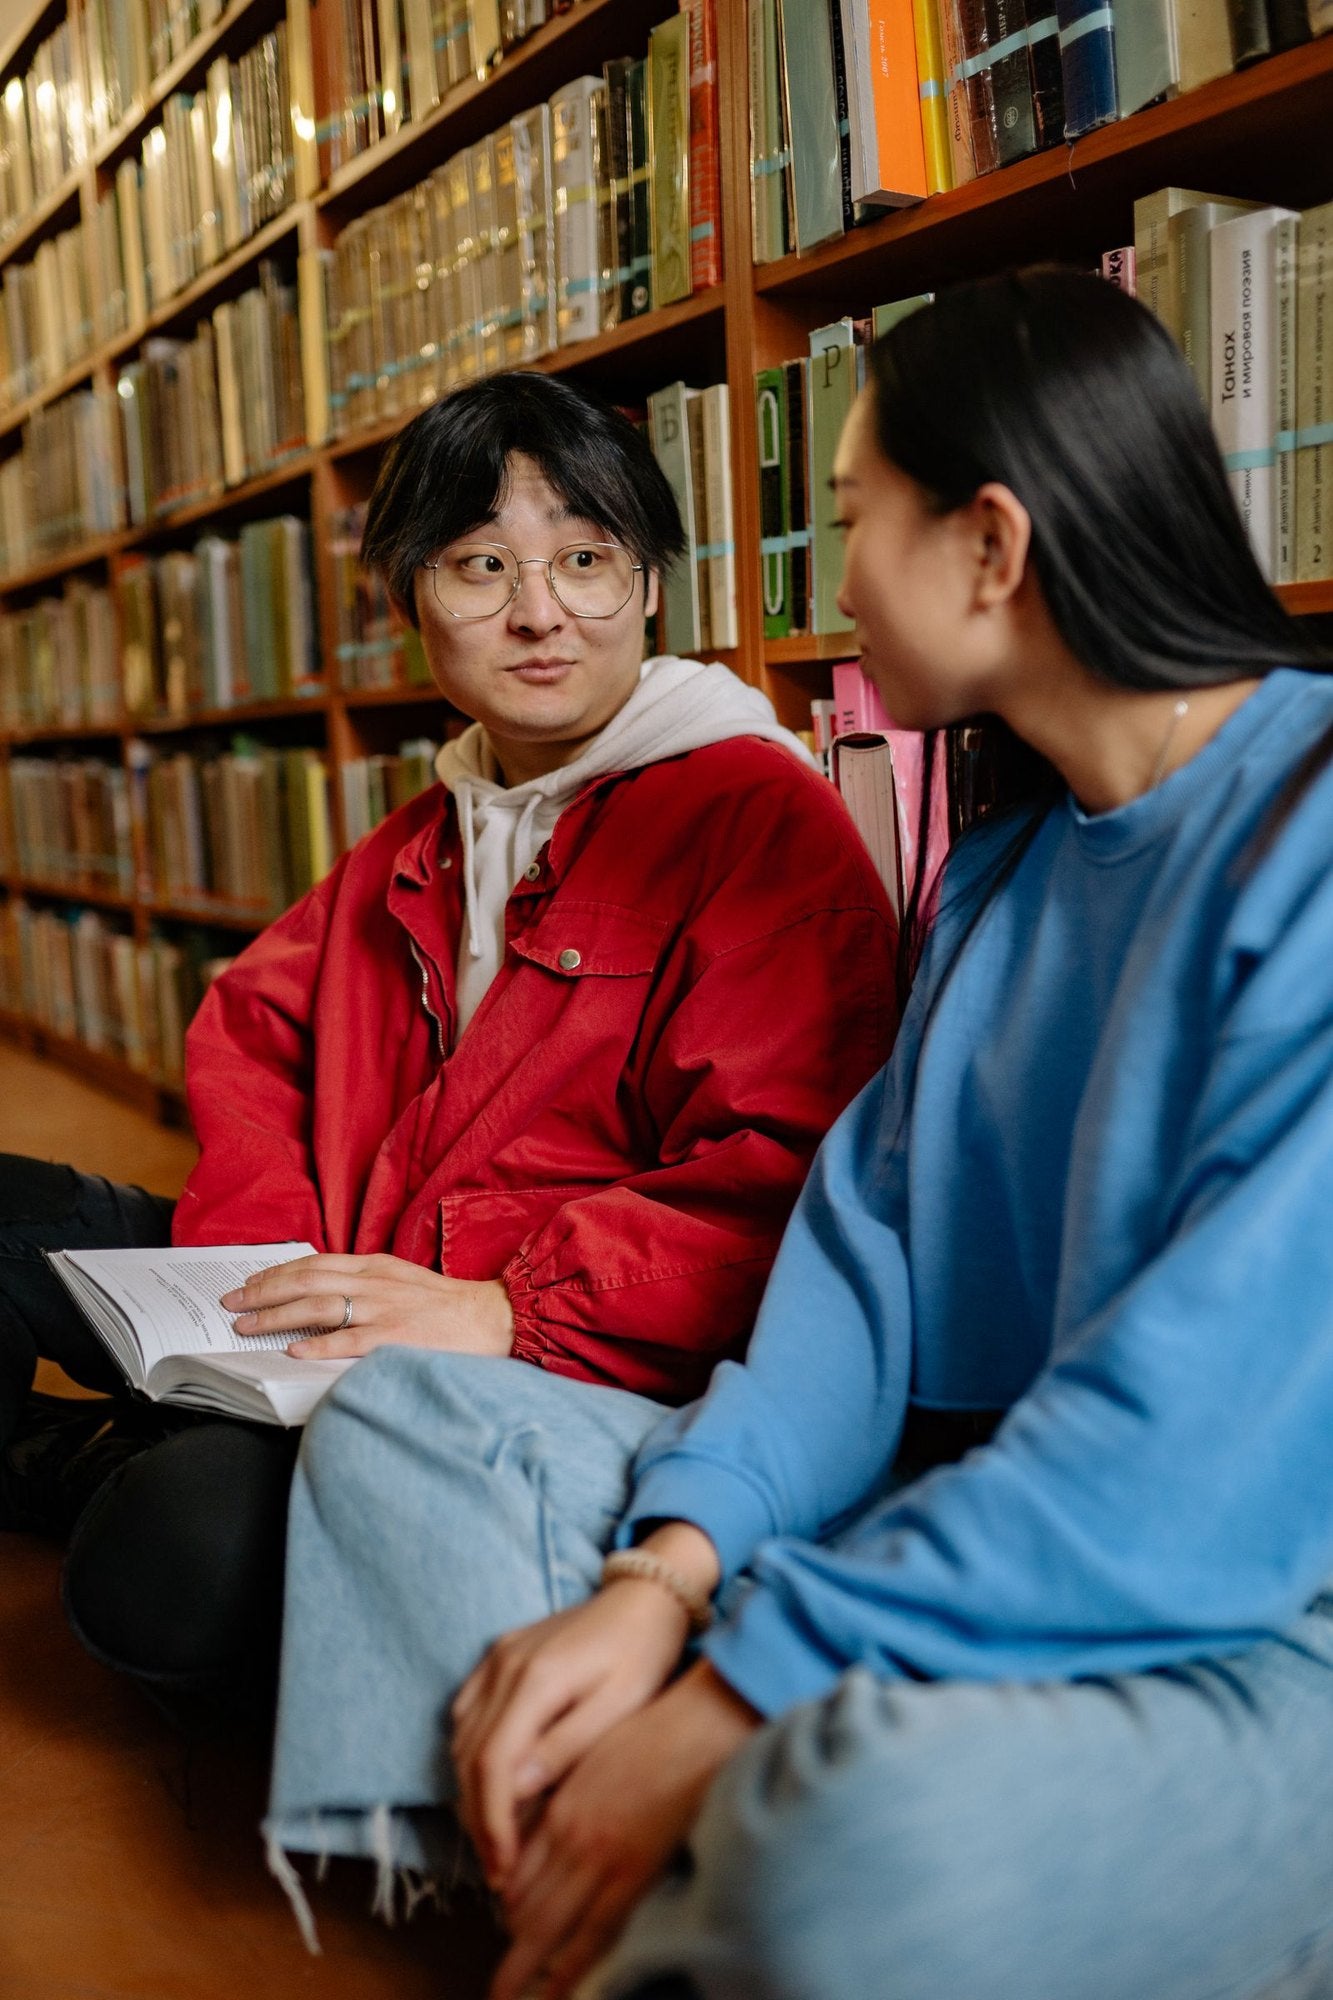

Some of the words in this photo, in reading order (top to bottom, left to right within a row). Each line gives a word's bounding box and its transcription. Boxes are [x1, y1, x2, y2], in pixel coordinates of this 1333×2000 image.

[881, 56, 889, 78] 2007
[1242, 249, 1252, 308] поэзия
[1222, 330, 1236, 404] Танах
[1242, 313, 1254, 384] мировая
[1242, 389, 1252, 398] и
[1313, 544, 1323, 563] 2
